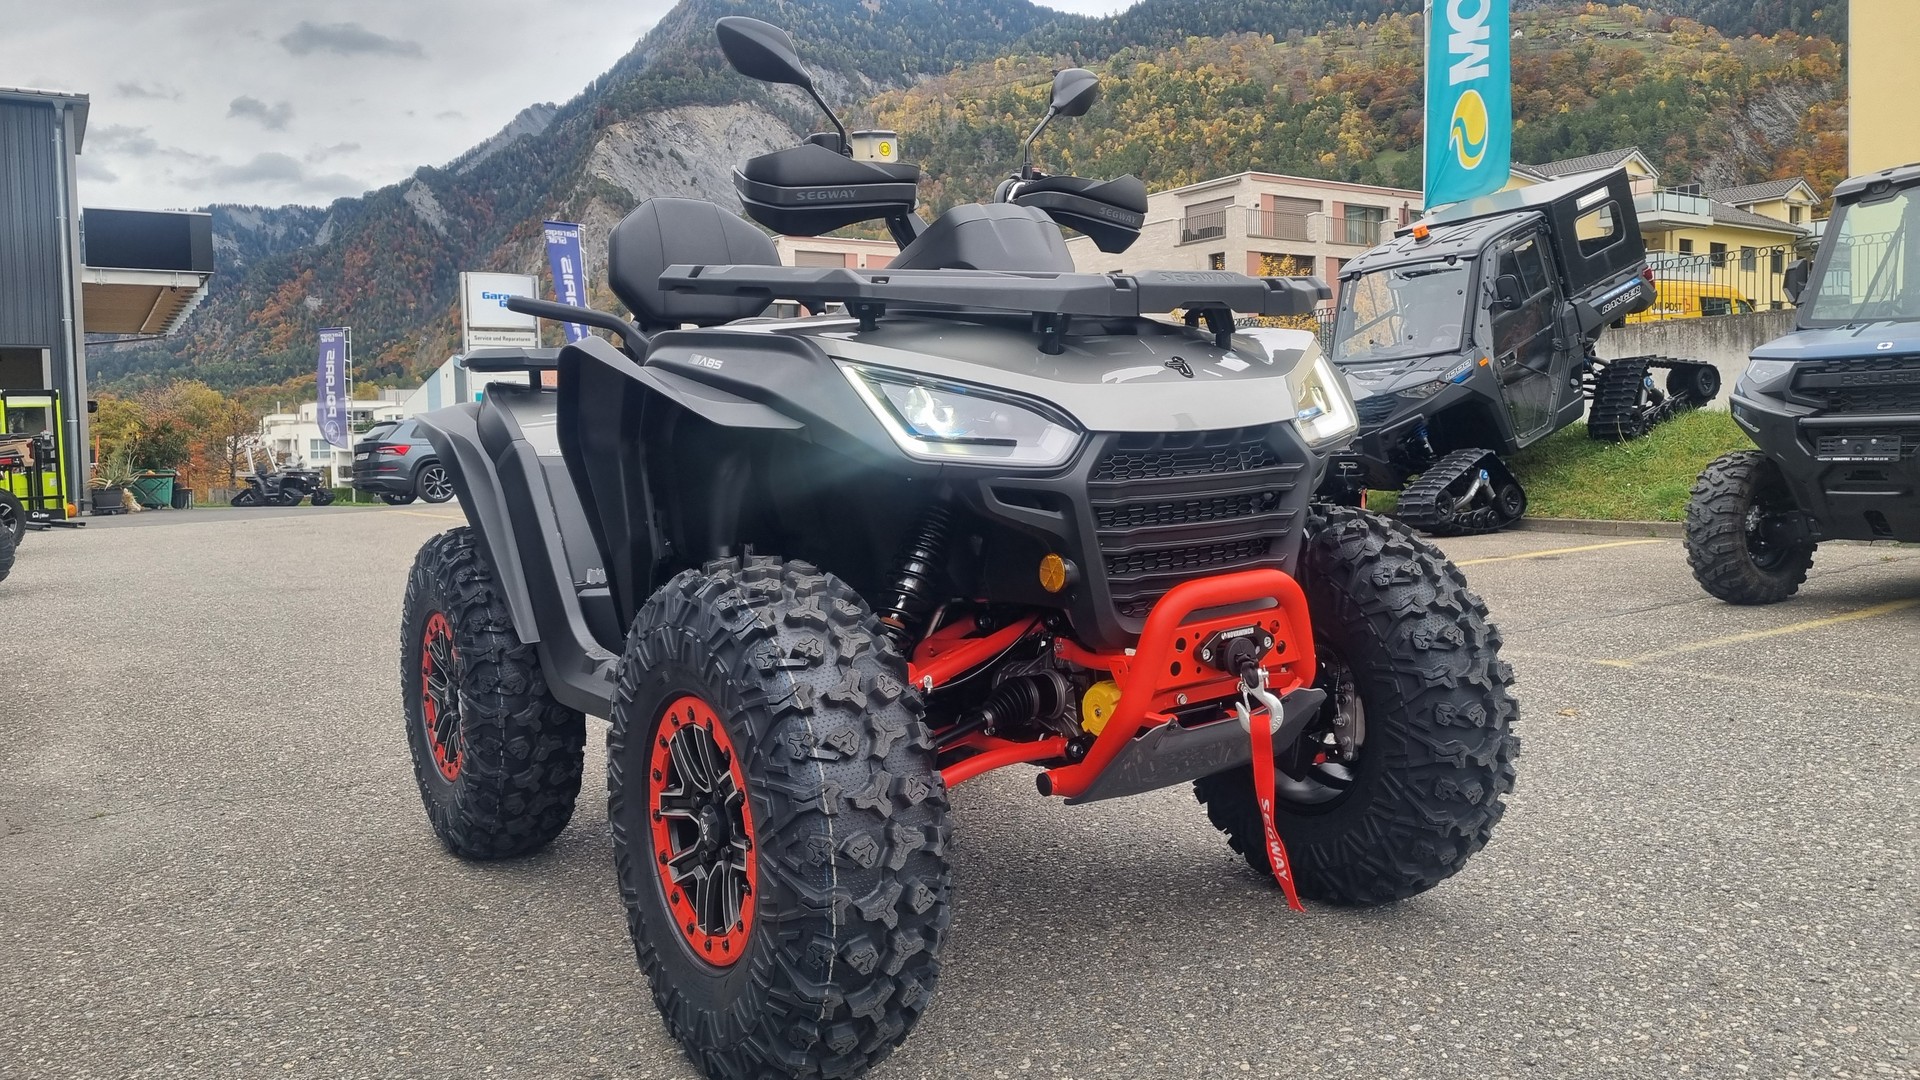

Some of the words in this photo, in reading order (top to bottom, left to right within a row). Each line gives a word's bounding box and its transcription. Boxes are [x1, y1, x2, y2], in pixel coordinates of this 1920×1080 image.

[796, 189, 857, 201] SEGWAY
[1098, 206, 1137, 224] SEGWAY
[1157, 272, 1237, 284] SEGWAY
[481, 291, 510, 300] Gara
[1601, 284, 1642, 315] RANGER
[1665, 302, 1682, 311] POST
[699, 356, 723, 370] ABS
[1261, 798, 1289, 881] SEGWAY
